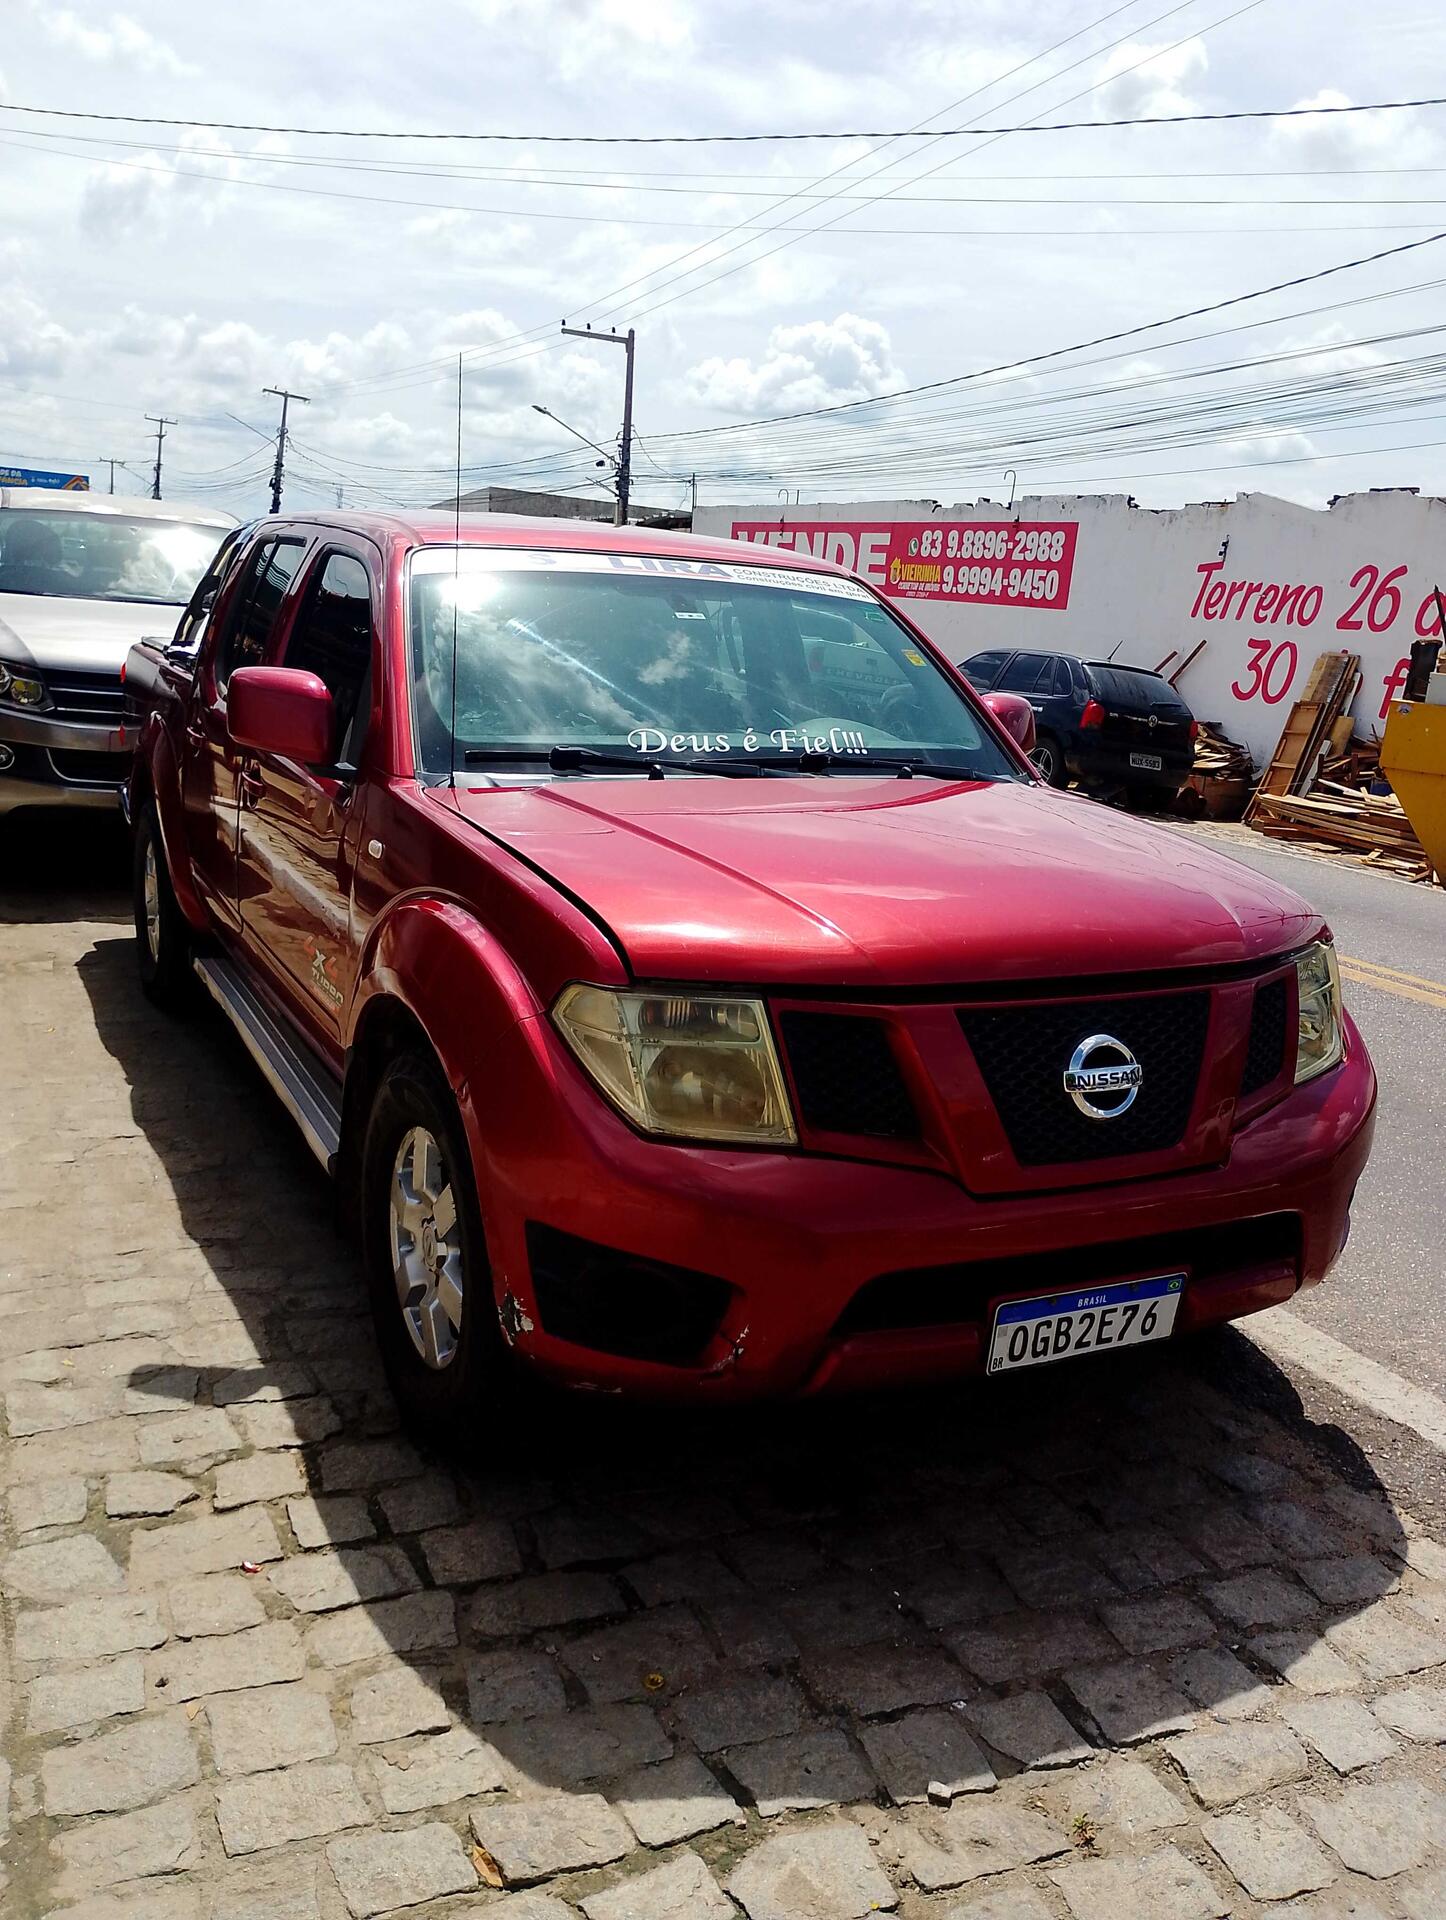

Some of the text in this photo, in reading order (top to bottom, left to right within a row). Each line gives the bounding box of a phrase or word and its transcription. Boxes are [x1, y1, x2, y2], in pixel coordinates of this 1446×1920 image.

[737, 531, 891, 586] NDE
[920, 529, 1066, 562] 83 9.8896-2988
[607, 556, 732, 577] LIRA
[941, 565, 1060, 601] 9.9994-9450
[1190, 561, 1324, 627] Terreno
[1336, 564, 1408, 633] 26
[1231, 638, 1298, 704] 30
[627, 727, 868, 755] Deus é Fiel!!!
[1076, 1066, 1140, 1087] NISSAN
[1077, 1294, 1107, 1308] BRASIL
[1008, 1300, 1160, 1362] OGB2E76
[992, 1357, 1004, 1370] BR
